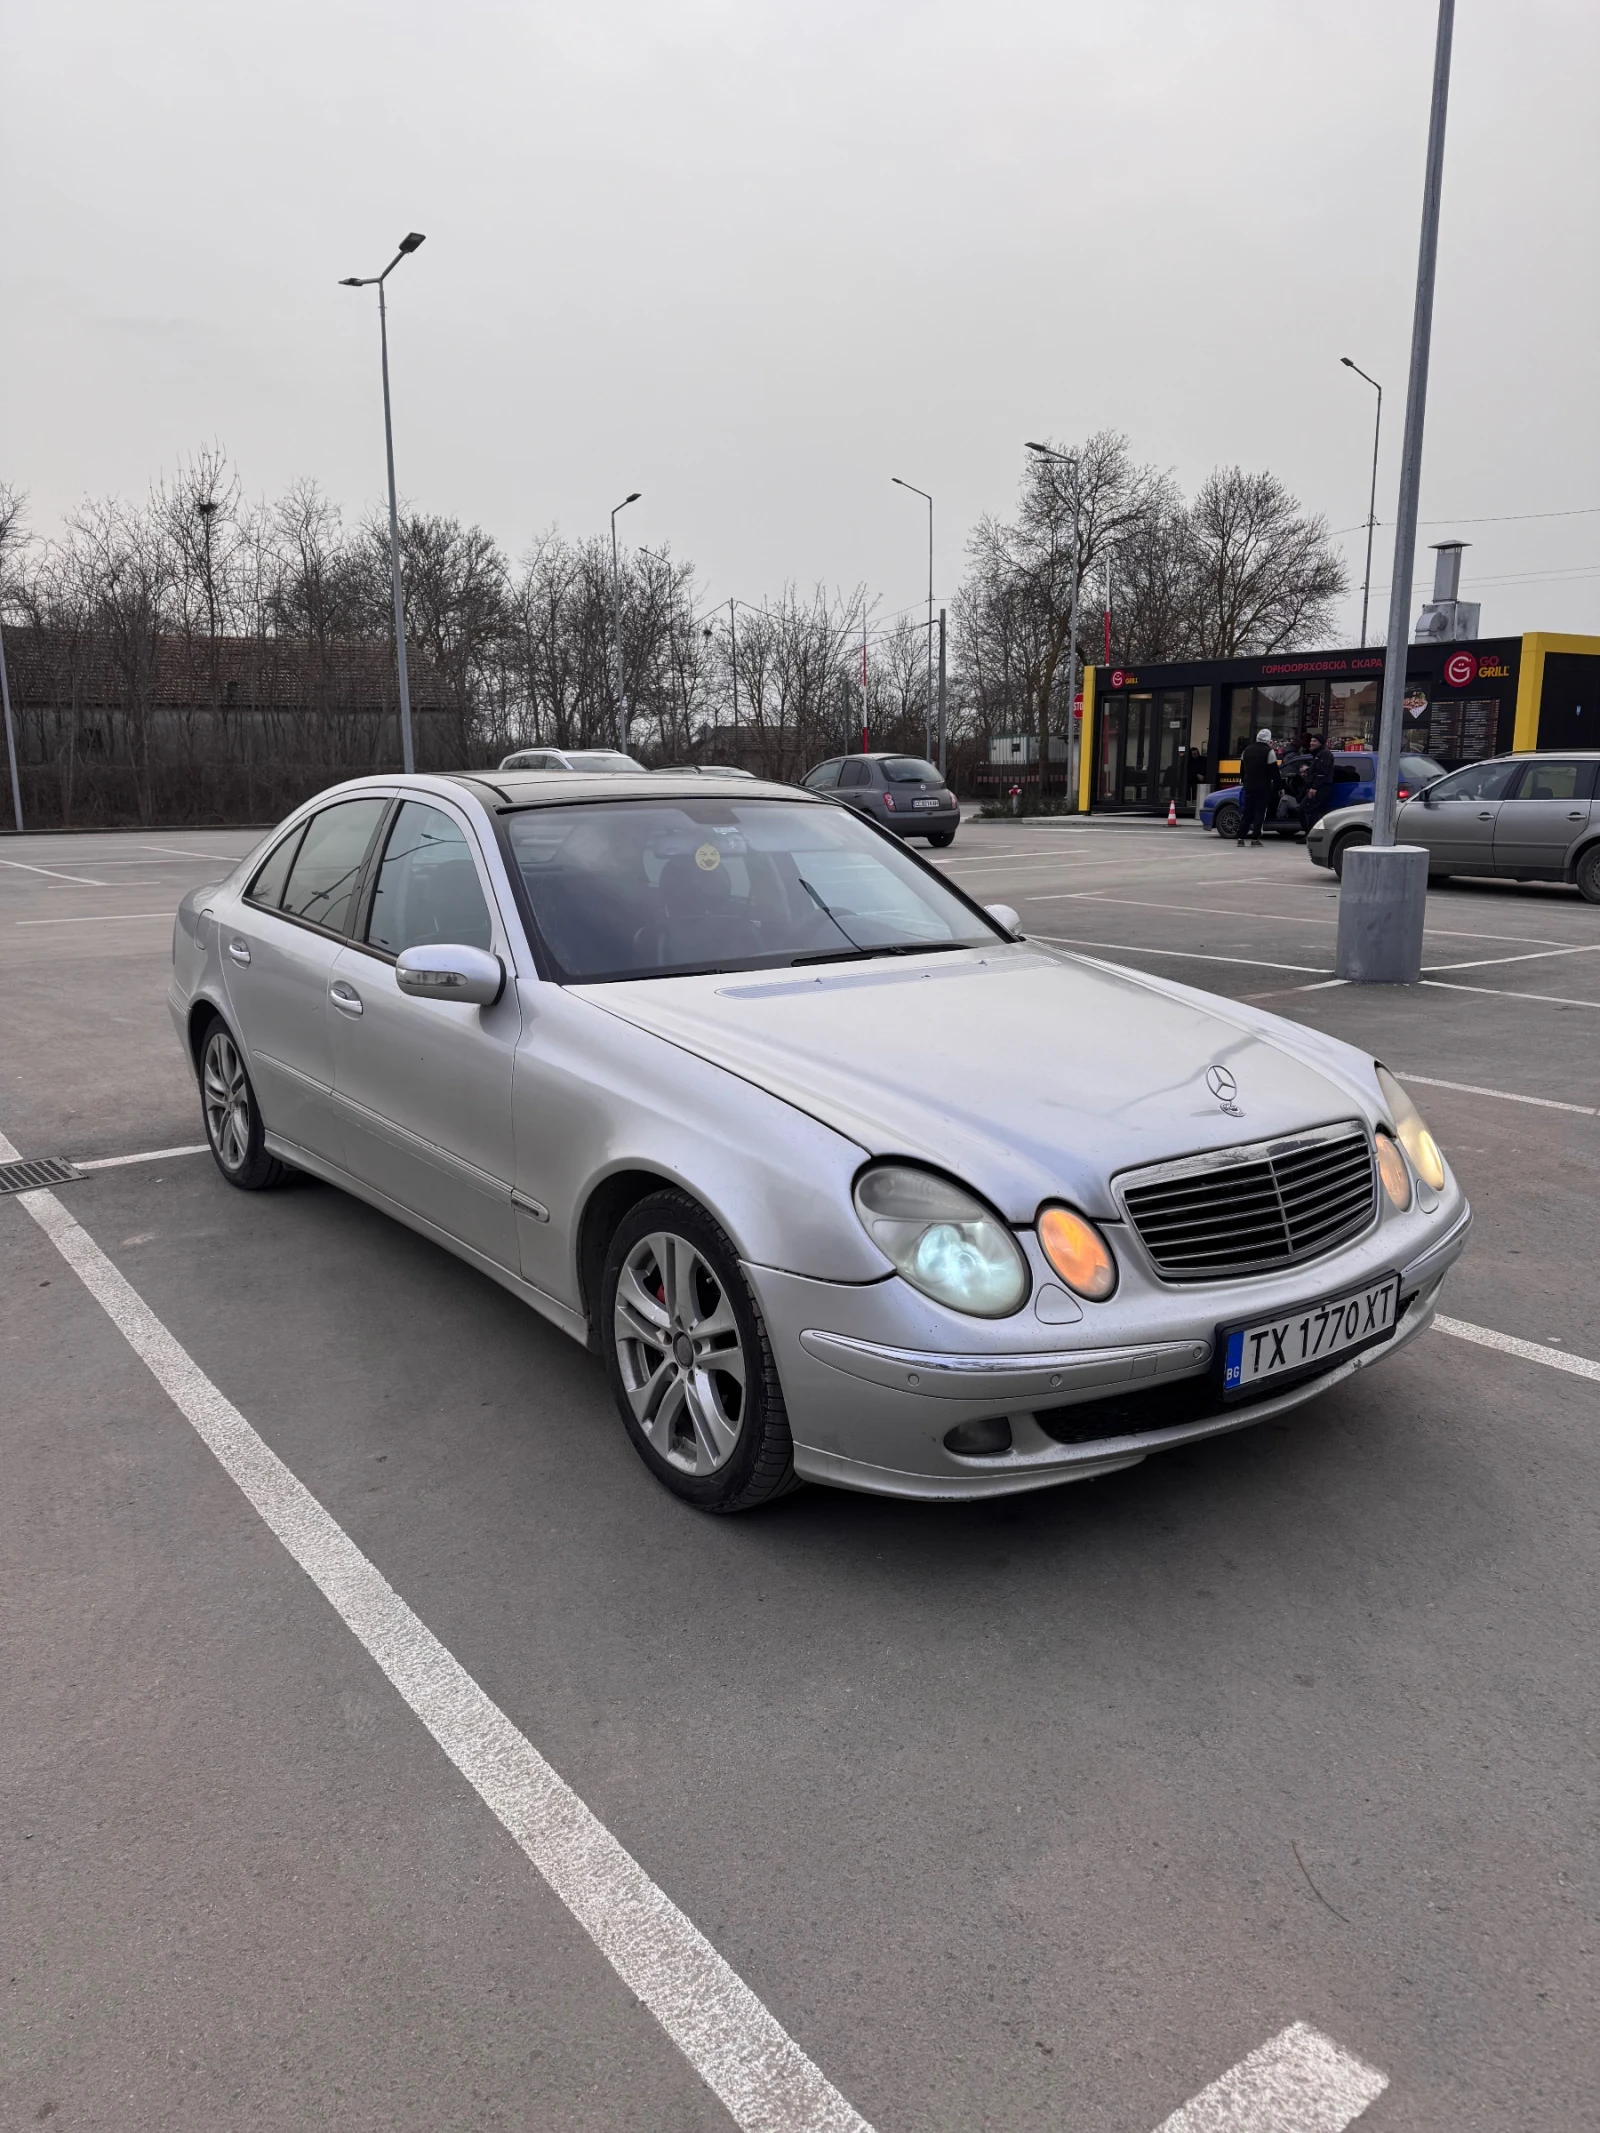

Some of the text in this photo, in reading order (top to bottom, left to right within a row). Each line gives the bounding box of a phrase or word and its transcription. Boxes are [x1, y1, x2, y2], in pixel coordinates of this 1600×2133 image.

[1262, 658, 1383, 674] ГОРНООРЯХОВСКА СКАРА
[1479, 655, 1499, 666] GO
[1478, 666, 1509, 678] GRILL
[1074, 702, 1083, 711] STO
[1250, 1285, 1394, 1373] TX 1770 XT
[1226, 1365, 1240, 1381] BG
